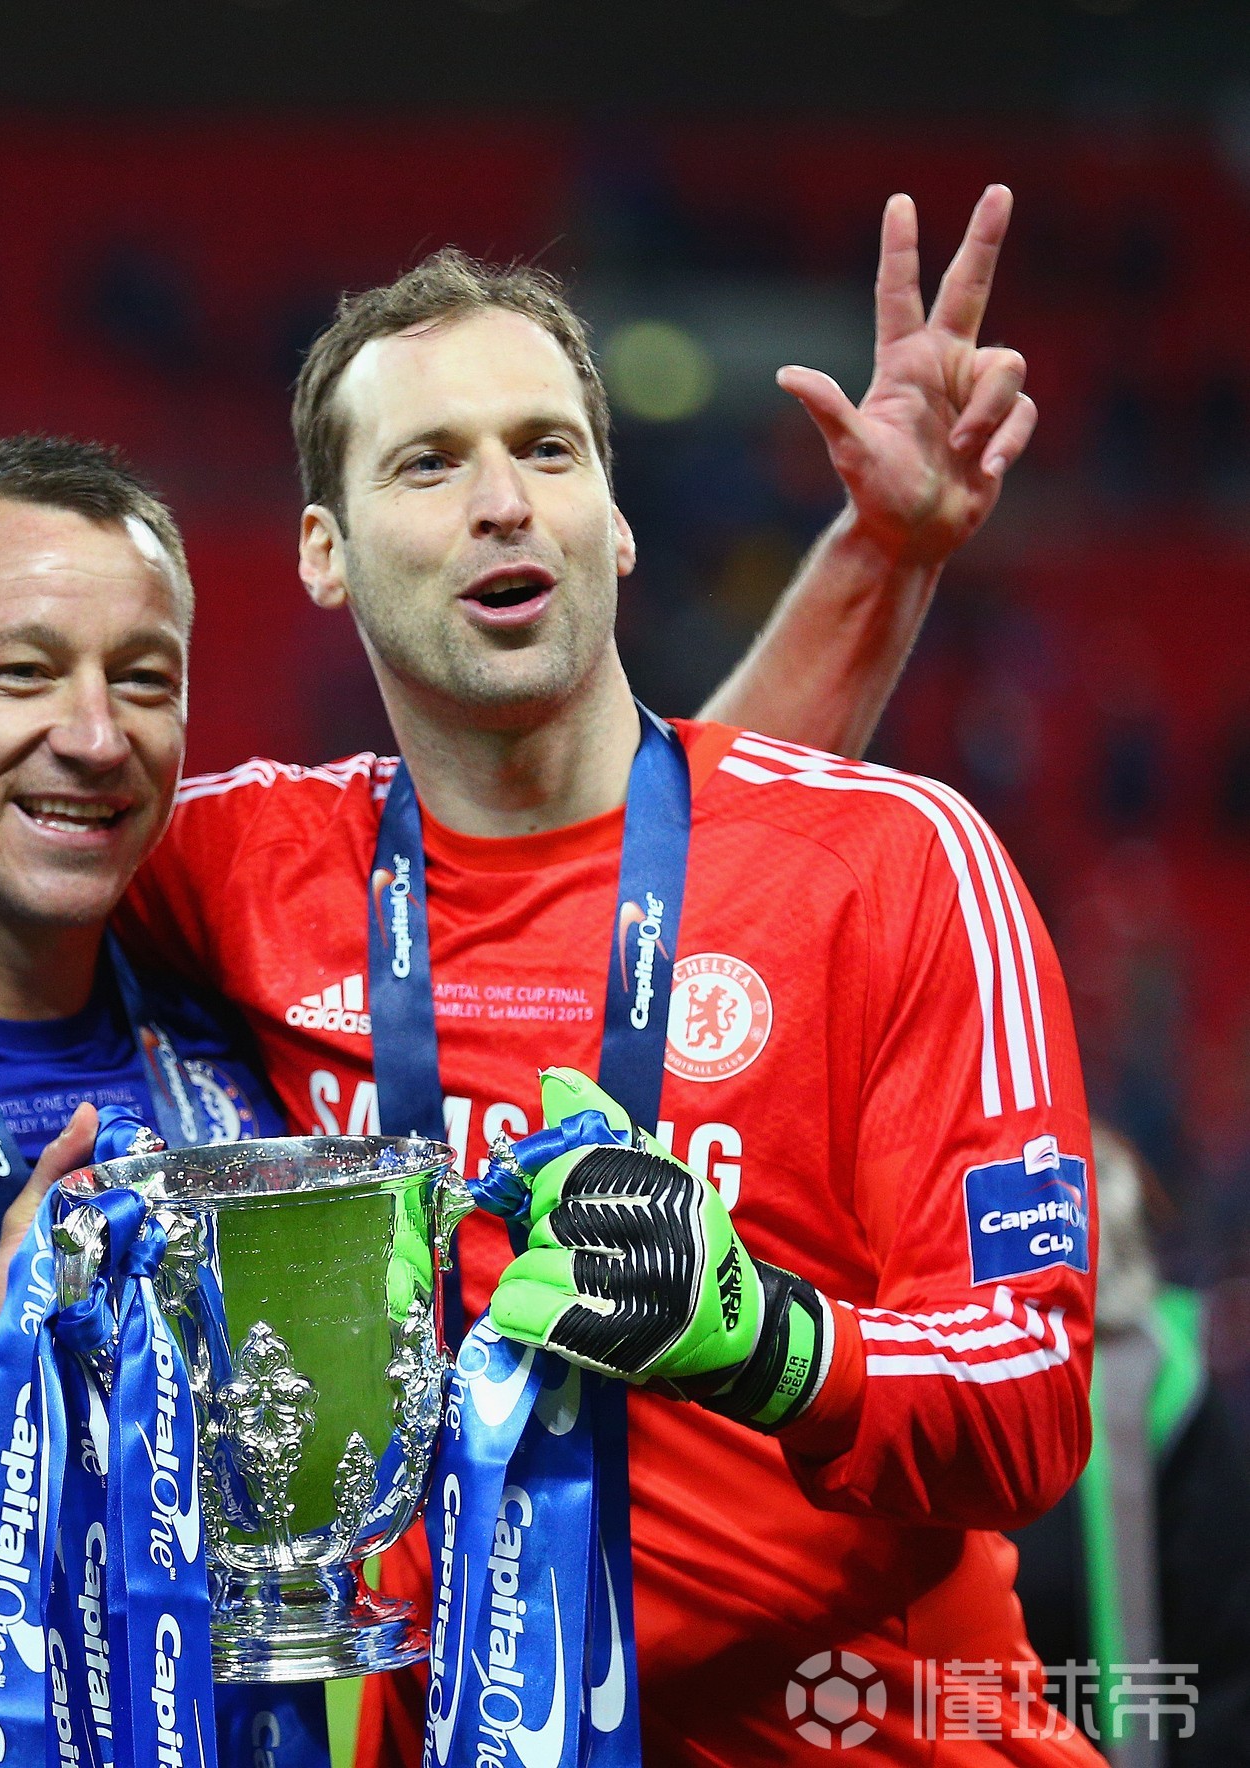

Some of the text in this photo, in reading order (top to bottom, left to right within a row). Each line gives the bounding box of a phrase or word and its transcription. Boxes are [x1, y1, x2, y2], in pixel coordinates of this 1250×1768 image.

[630, 896, 665, 1030] CapitalOne
[673, 958, 753, 989] CHELSEA
[434, 983, 588, 1004] APITAL ONE CUP FINAL
[284, 1004, 372, 1036] adidas
[435, 1002, 483, 1019] EMBLEY
[505, 1006, 554, 1021] MARCH
[557, 1007, 594, 1022] 2015
[667, 1053, 746, 1074] OOTBALL CLUB
[1029, 1232, 1074, 1256] Cup
[787, 1358, 810, 1397] CECH
[152, 1300, 181, 1565] apitalOne
[78, 1522, 114, 1740] Capital
[151, 1613, 183, 1768] Capit
